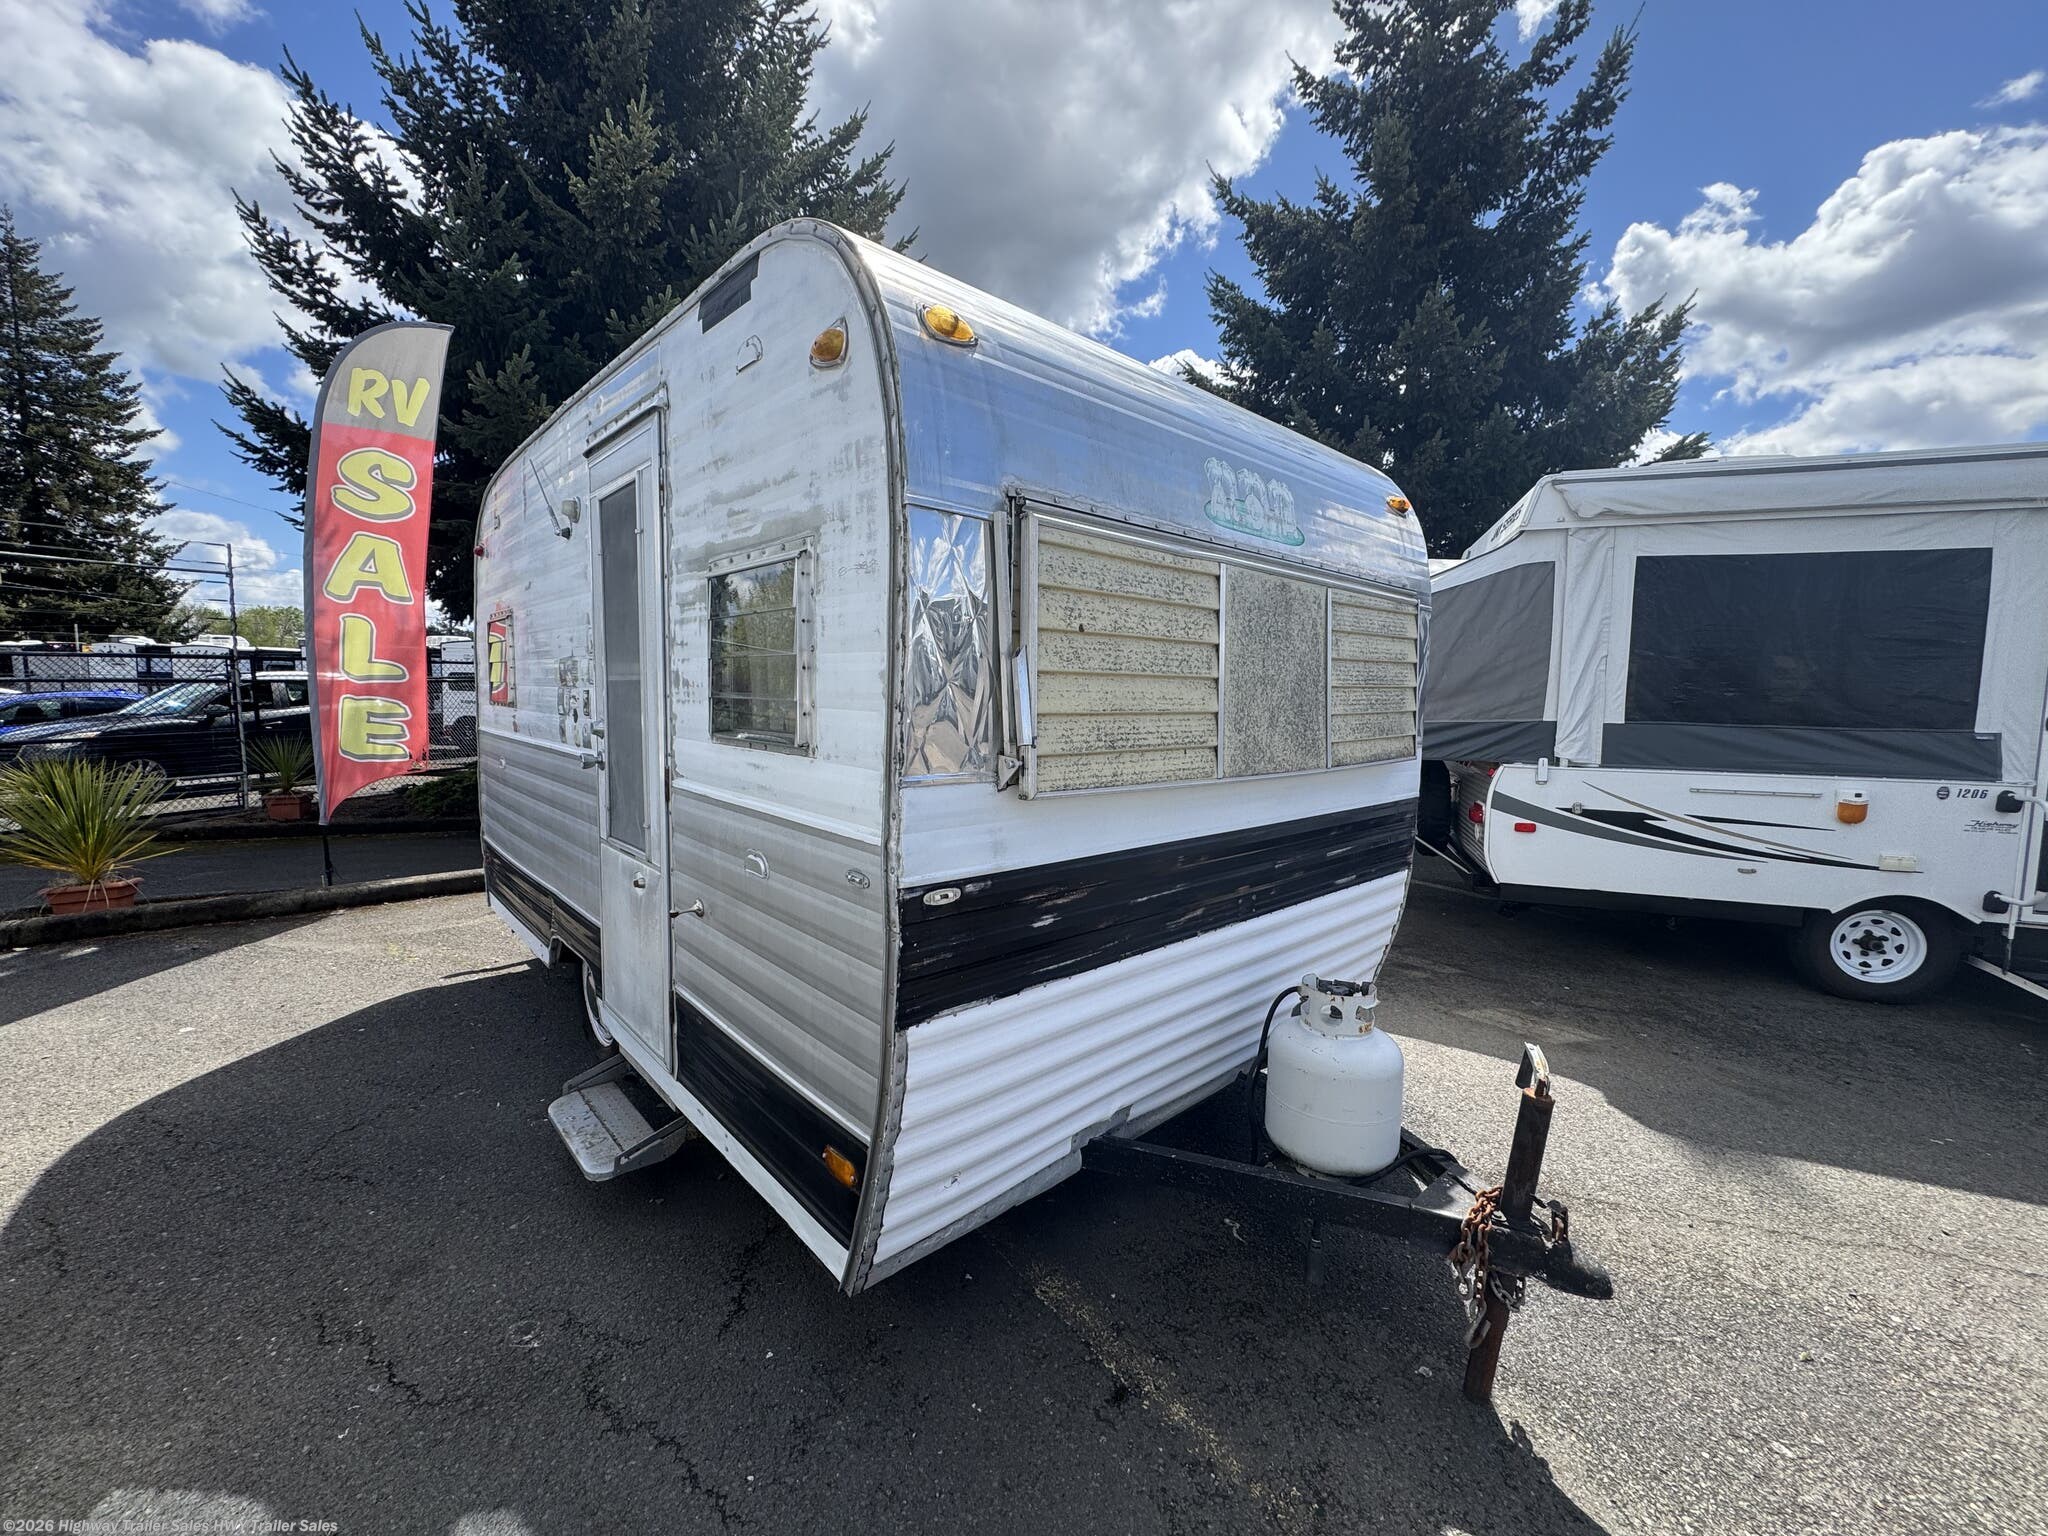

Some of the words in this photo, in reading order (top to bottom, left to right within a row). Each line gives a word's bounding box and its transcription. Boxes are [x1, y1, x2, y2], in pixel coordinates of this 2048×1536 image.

[347, 367, 431, 427] RV
[323, 447, 417, 762] SALE
[1956, 788, 1989, 799] 1206
